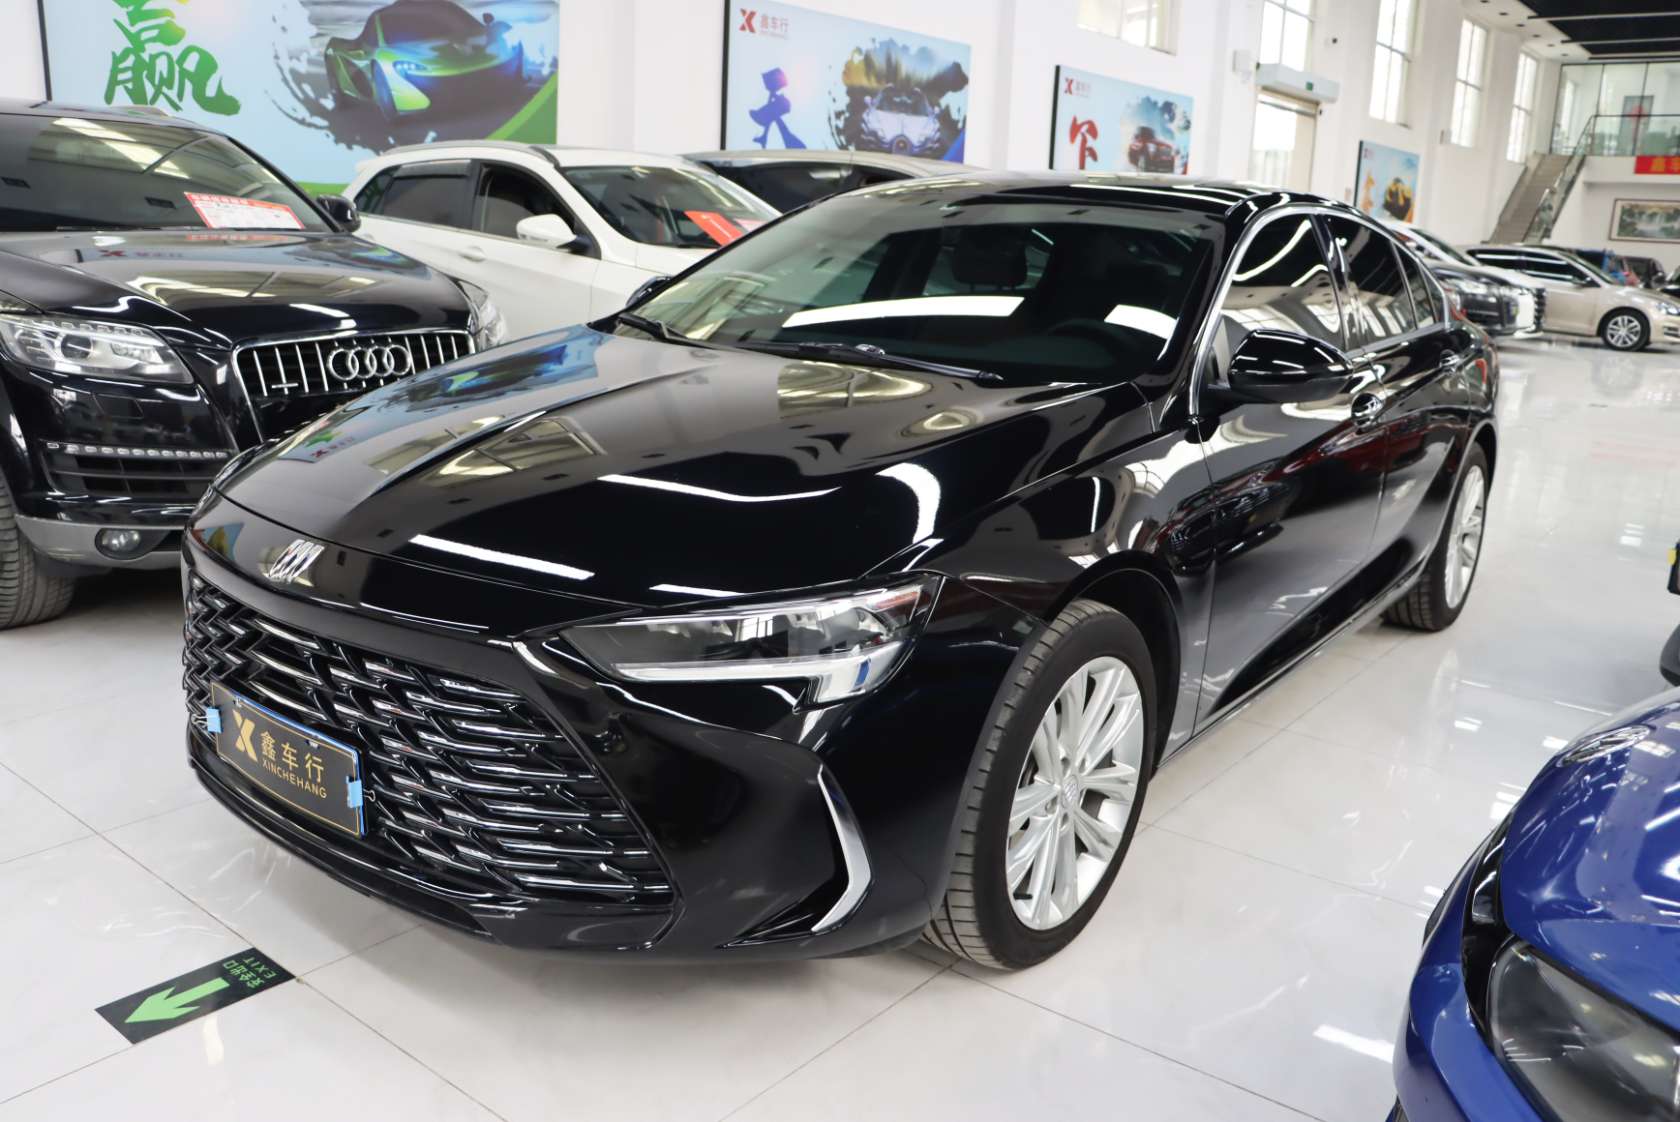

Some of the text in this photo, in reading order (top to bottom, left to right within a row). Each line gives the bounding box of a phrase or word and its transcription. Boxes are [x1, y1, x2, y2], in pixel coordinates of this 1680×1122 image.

[104, 0, 241, 116] 赢
[260, 731, 325, 784] 鑫车行
[262, 759, 328, 799] XINCHEHANG
[223, 960, 265, 989] 安全出口
[243, 956, 278, 979] EXIT
